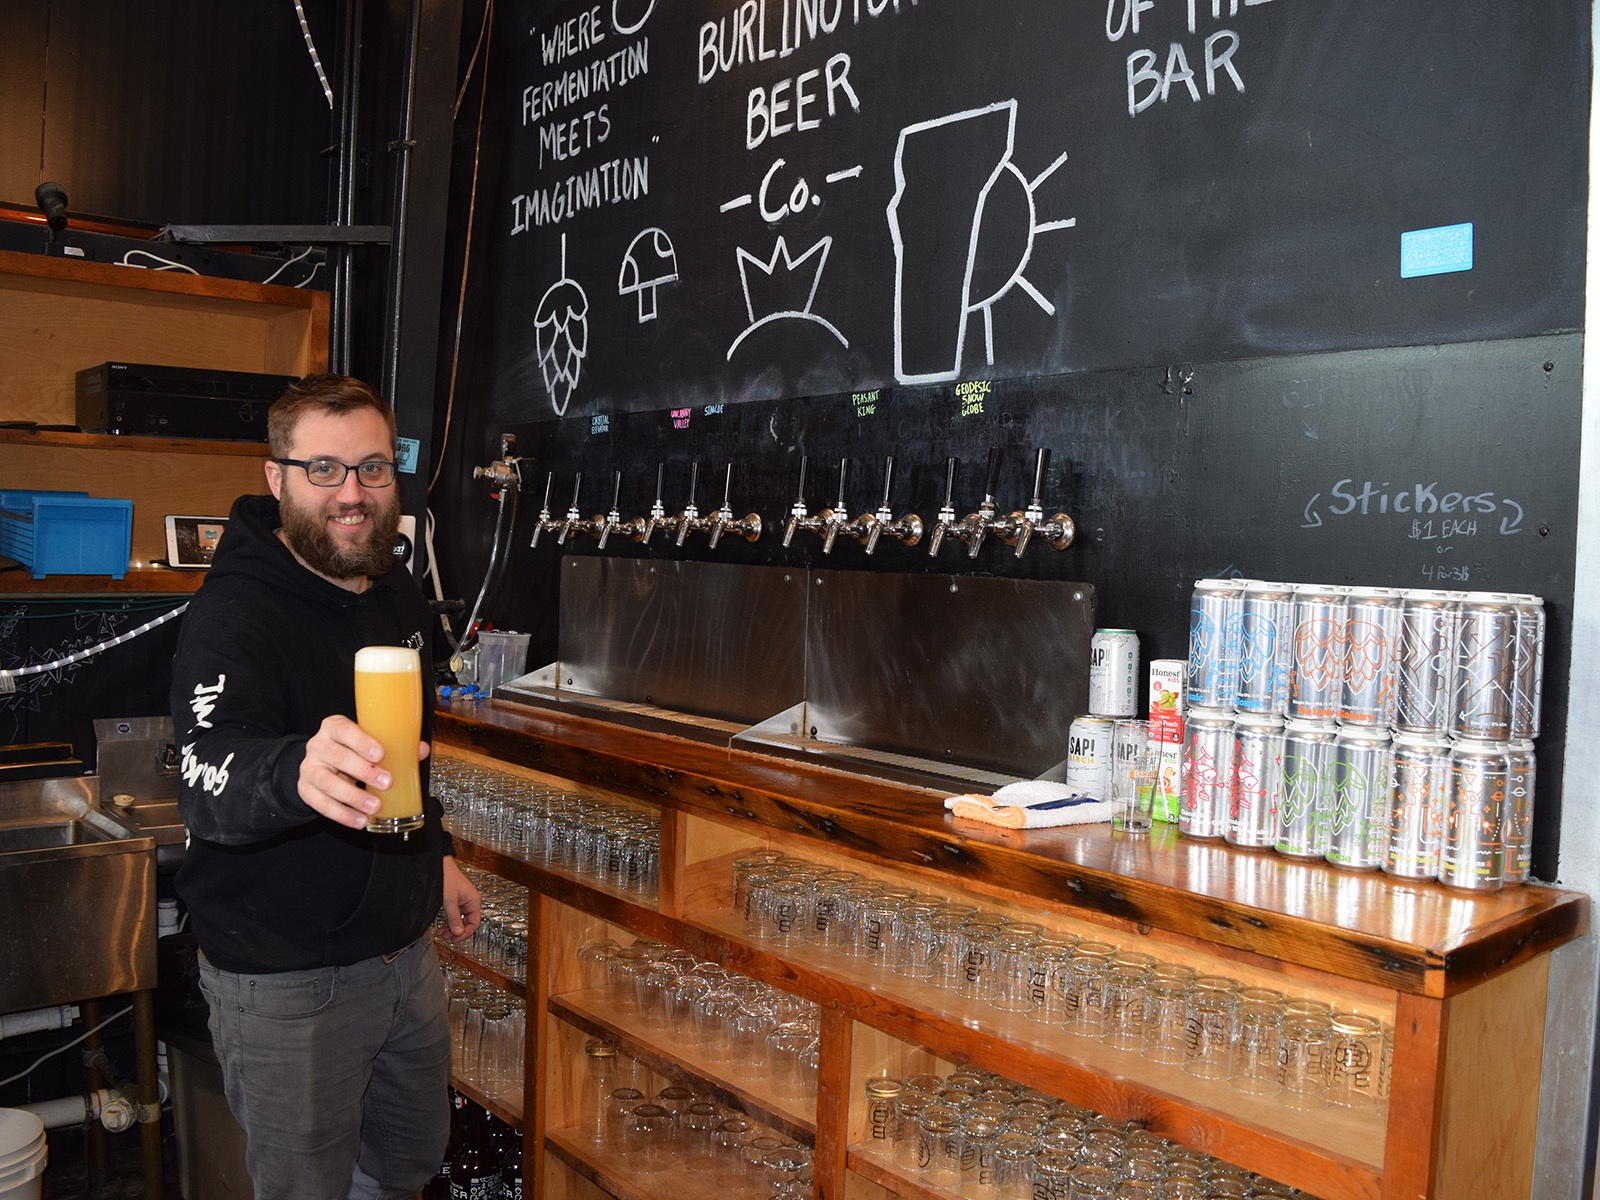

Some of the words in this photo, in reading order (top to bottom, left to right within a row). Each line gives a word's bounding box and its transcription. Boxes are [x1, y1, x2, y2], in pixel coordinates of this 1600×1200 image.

[523, 36, 649, 126] FERMENTATION
[1127, 29, 1246, 118] BAR
[746, 52, 860, 150] BEER
[539, 103, 611, 170] MEETS
[955, 381, 991, 396] GEODESIC
[852, 390, 880, 406] PEASANT
[962, 393, 984, 405] SNOW
[857, 404, 876, 418] KING
[962, 403, 984, 417] GLOBE
[1329, 479, 1496, 515] Stickers
[1408, 519, 1438, 540] $1
[1442, 519, 1477, 539] EACH
[1436, 545, 1453, 554] or
[1421, 564, 1434, 581] 4
[1151, 668, 1180, 677] Honest
[1297, 705, 1335, 718] Galaxy
[1338, 709, 1375, 723] Galaxy
[1069, 736, 1095, 757] SAP!
[1069, 755, 1094, 765] BIRCH
